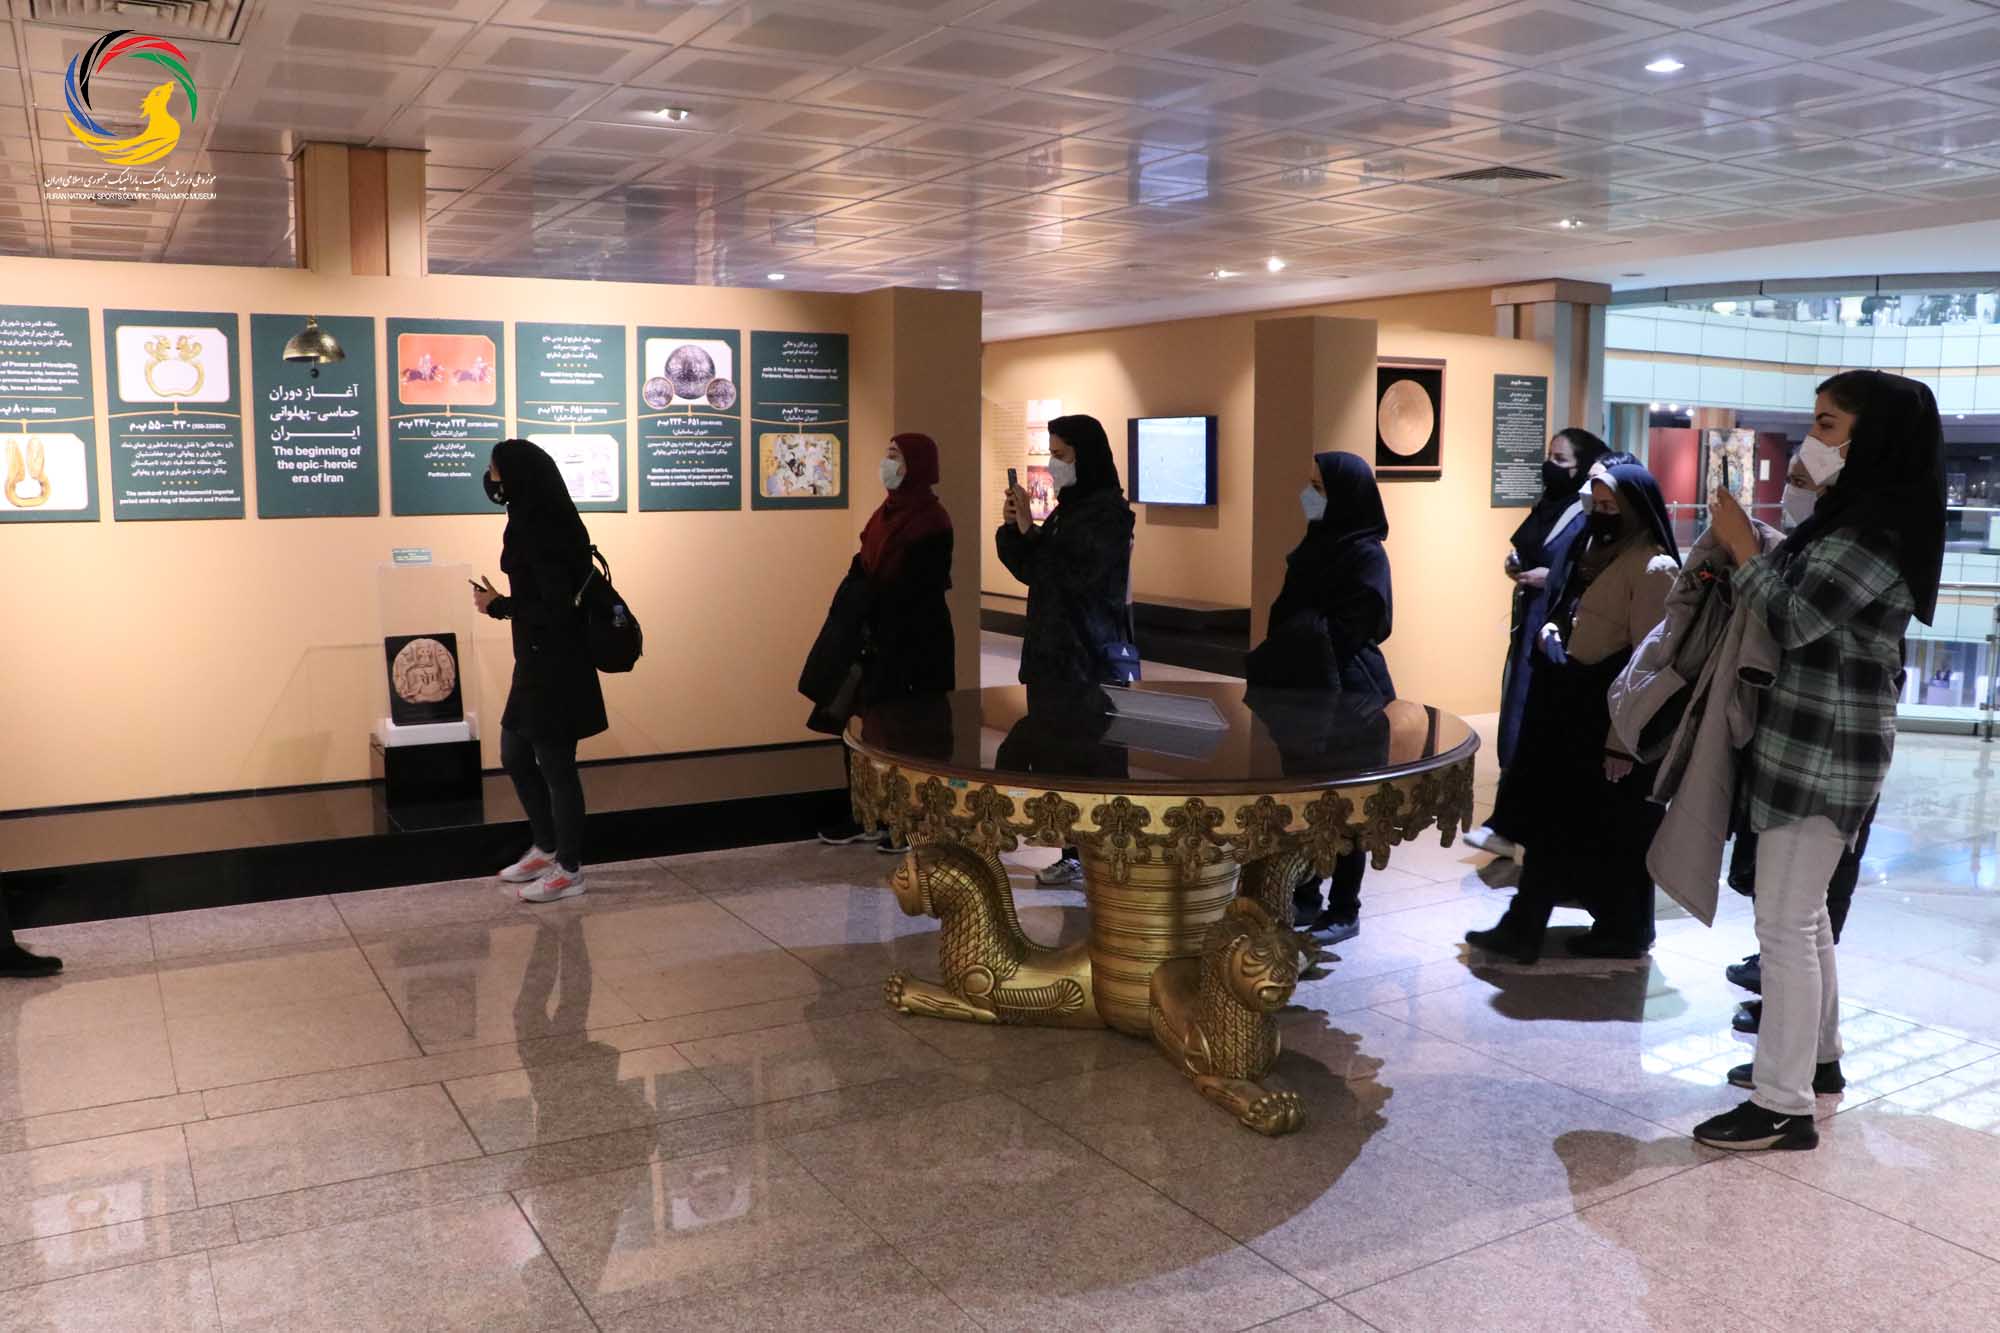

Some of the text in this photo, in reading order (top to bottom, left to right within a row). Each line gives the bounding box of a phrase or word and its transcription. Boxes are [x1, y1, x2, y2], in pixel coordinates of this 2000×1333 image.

[269, 383, 359, 401] آغاز دوران
[271, 425, 361, 441] ایران
[272, 446, 362, 458] The beginning of
[277, 460, 358, 472] the epic-heroic
[292, 473, 345, 483] era of Iran
